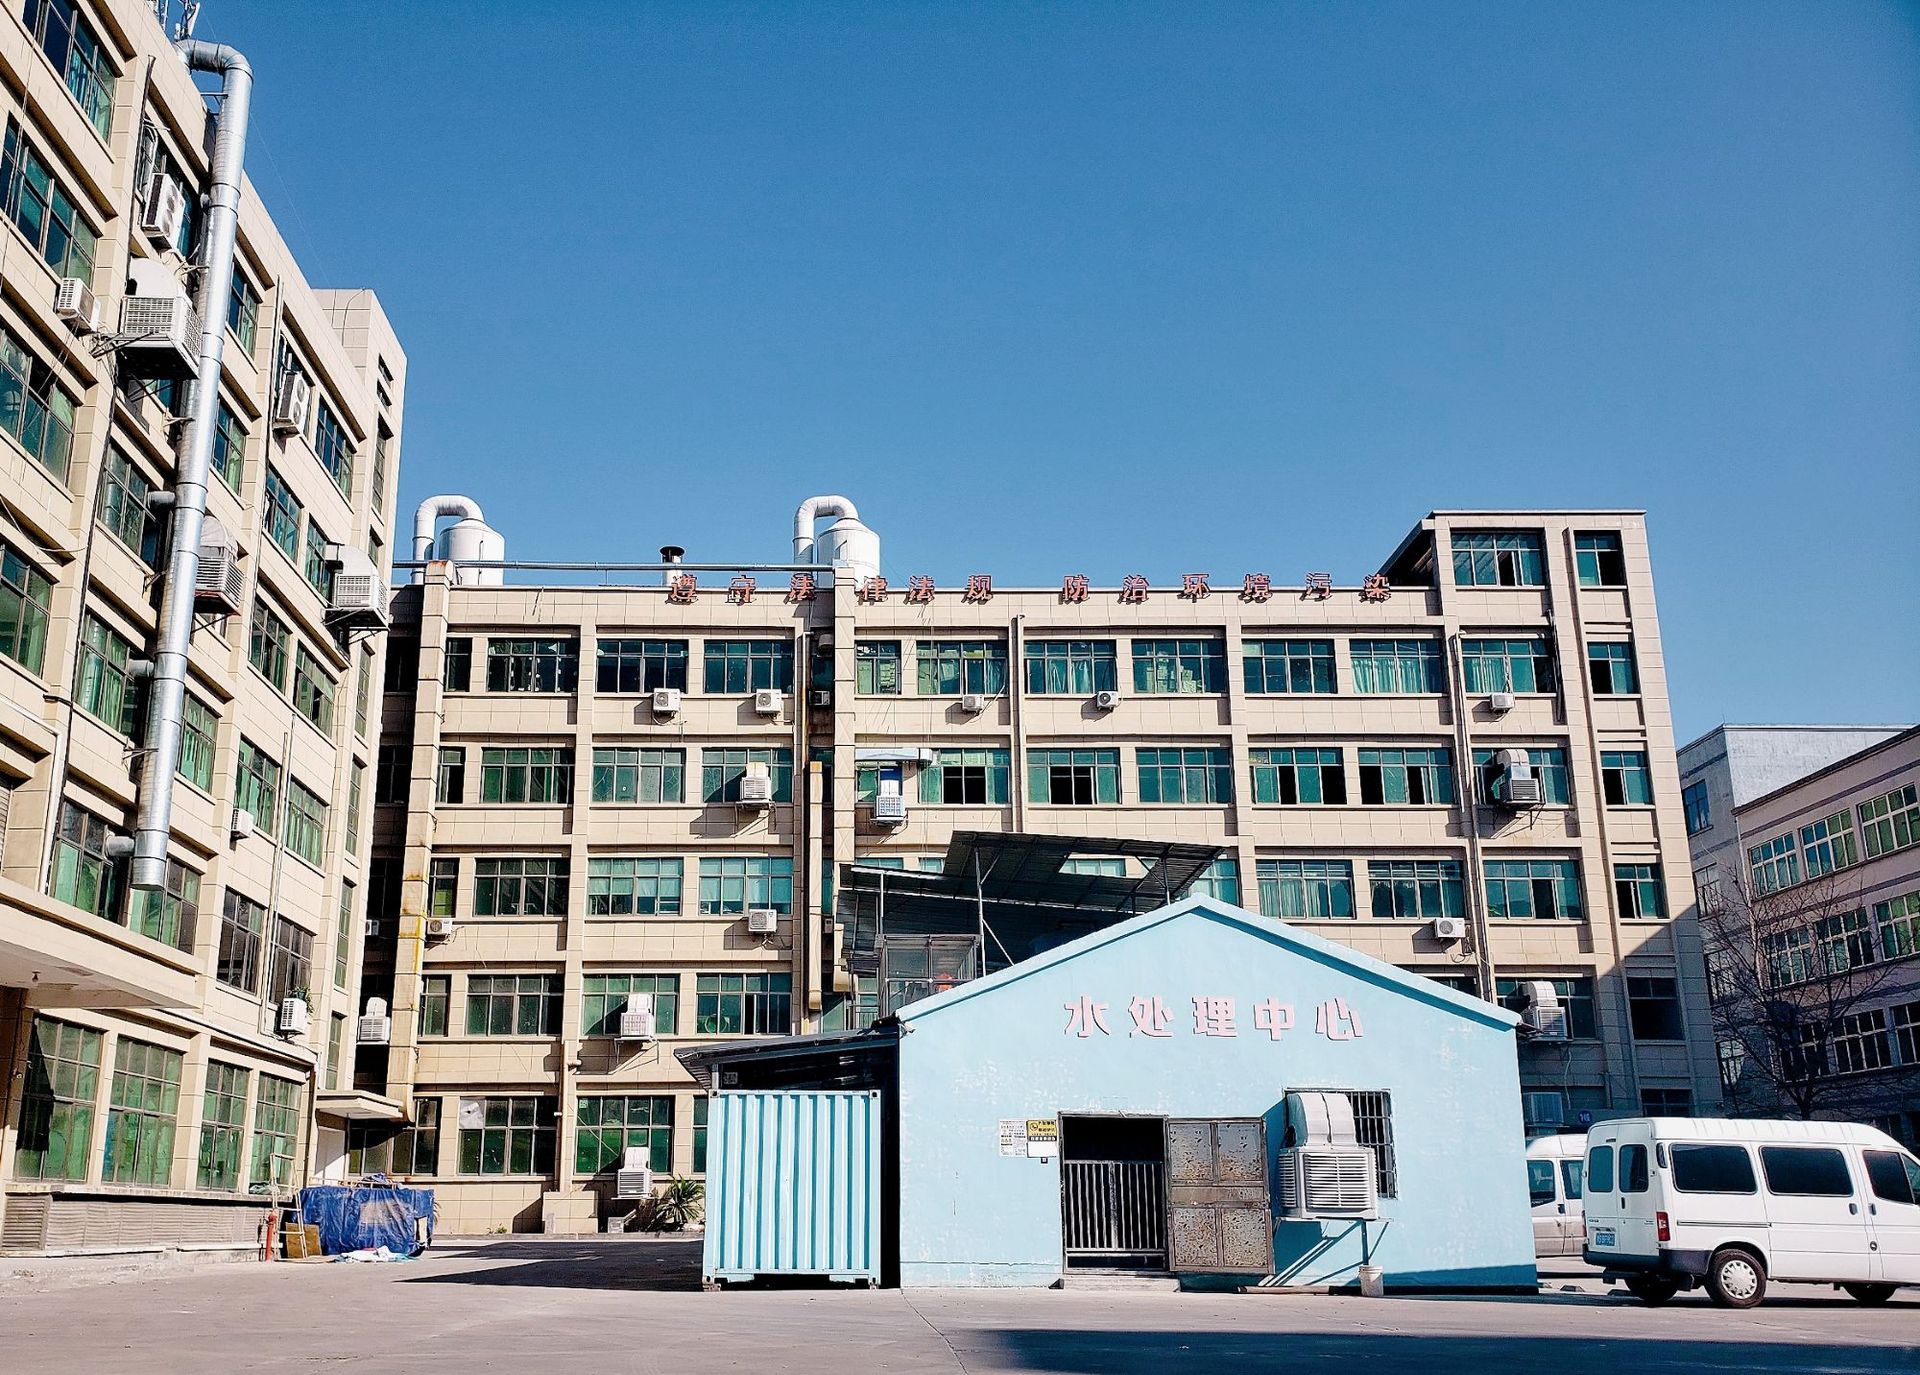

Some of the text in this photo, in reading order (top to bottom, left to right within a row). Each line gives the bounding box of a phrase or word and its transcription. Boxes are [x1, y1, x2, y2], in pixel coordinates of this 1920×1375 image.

[670, 572, 1391, 602] 遵守法律法规 防治环境污染
[1063, 995, 1364, 1041] 水处理中心
